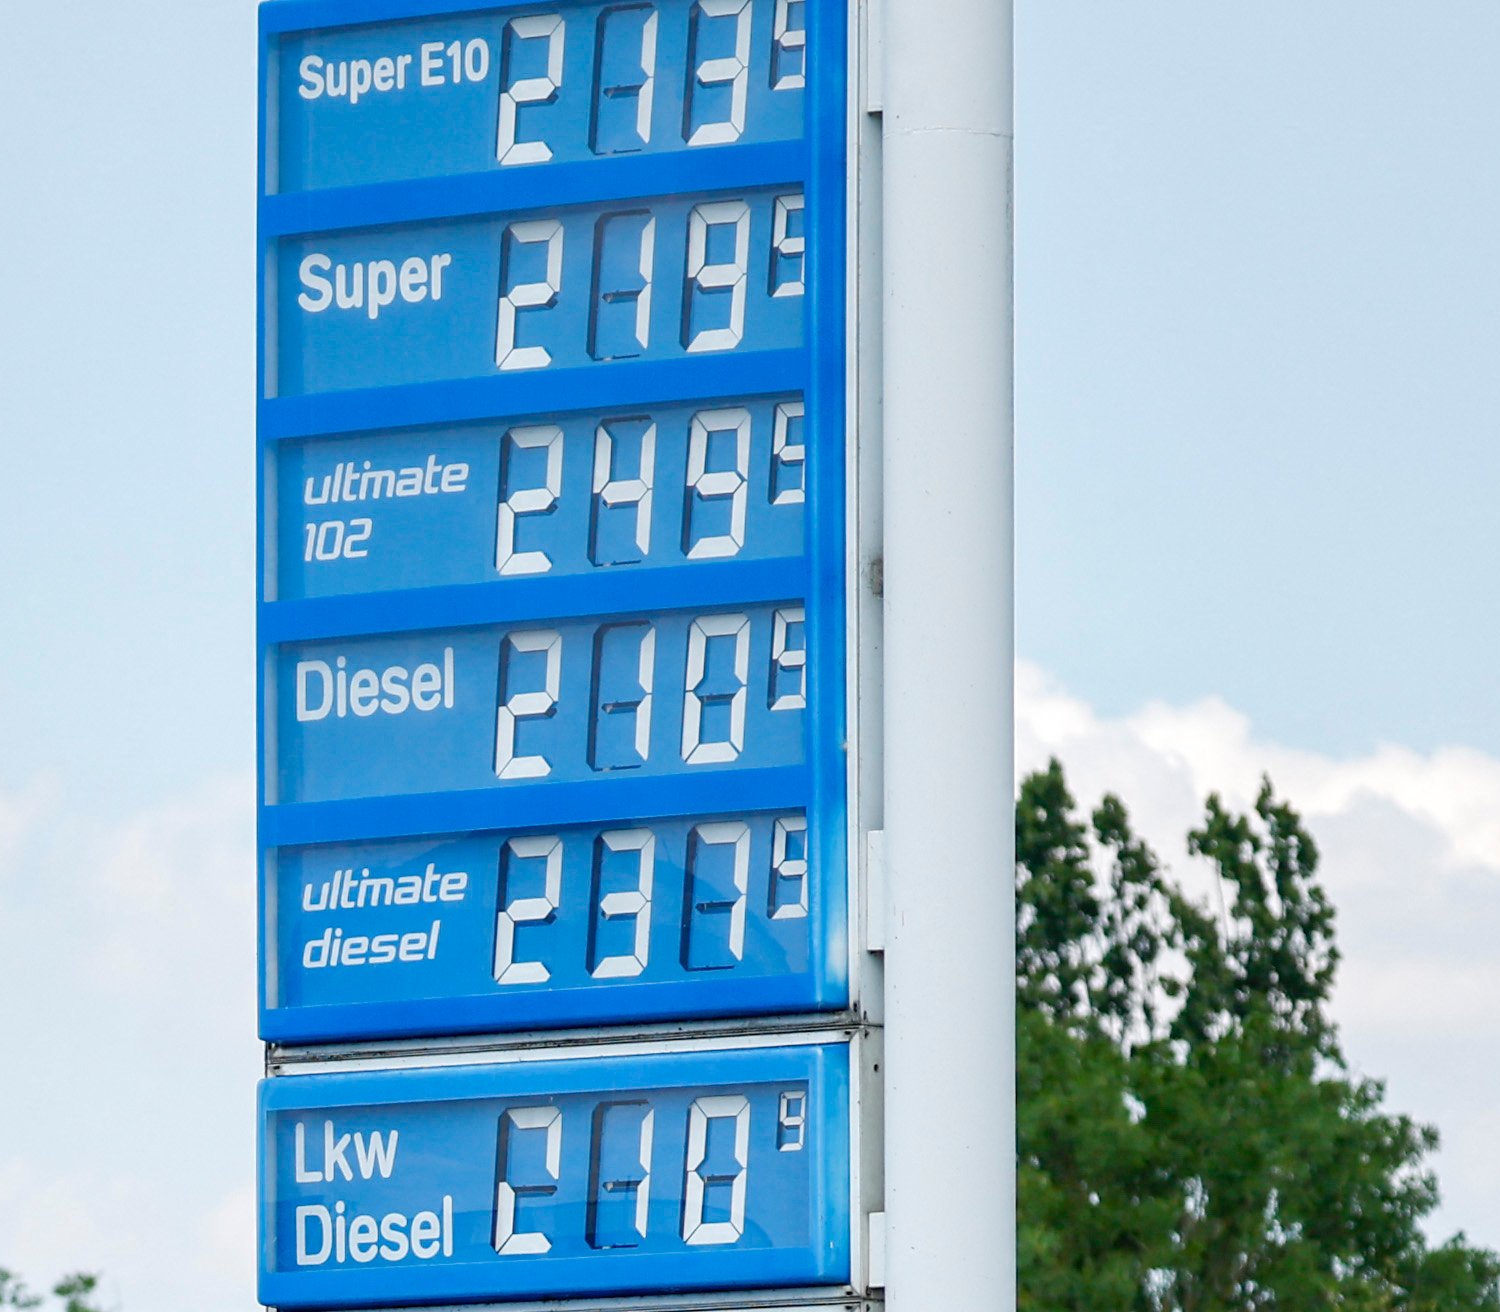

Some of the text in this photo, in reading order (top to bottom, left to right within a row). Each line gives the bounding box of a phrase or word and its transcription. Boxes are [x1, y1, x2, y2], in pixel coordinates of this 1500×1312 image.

[298, 54, 412, 104] Super
[421, 38, 490, 86] E10
[298, 253, 451, 319] Super
[304, 454, 469, 505] ultimate
[304, 518, 373, 561] 102
[297, 647, 454, 721] Diesel
[303, 863, 468, 911] ultimate
[303, 920, 441, 968] diesel
[295, 1120, 398, 1183] Lkw
[296, 1195, 453, 1265] Diesel
